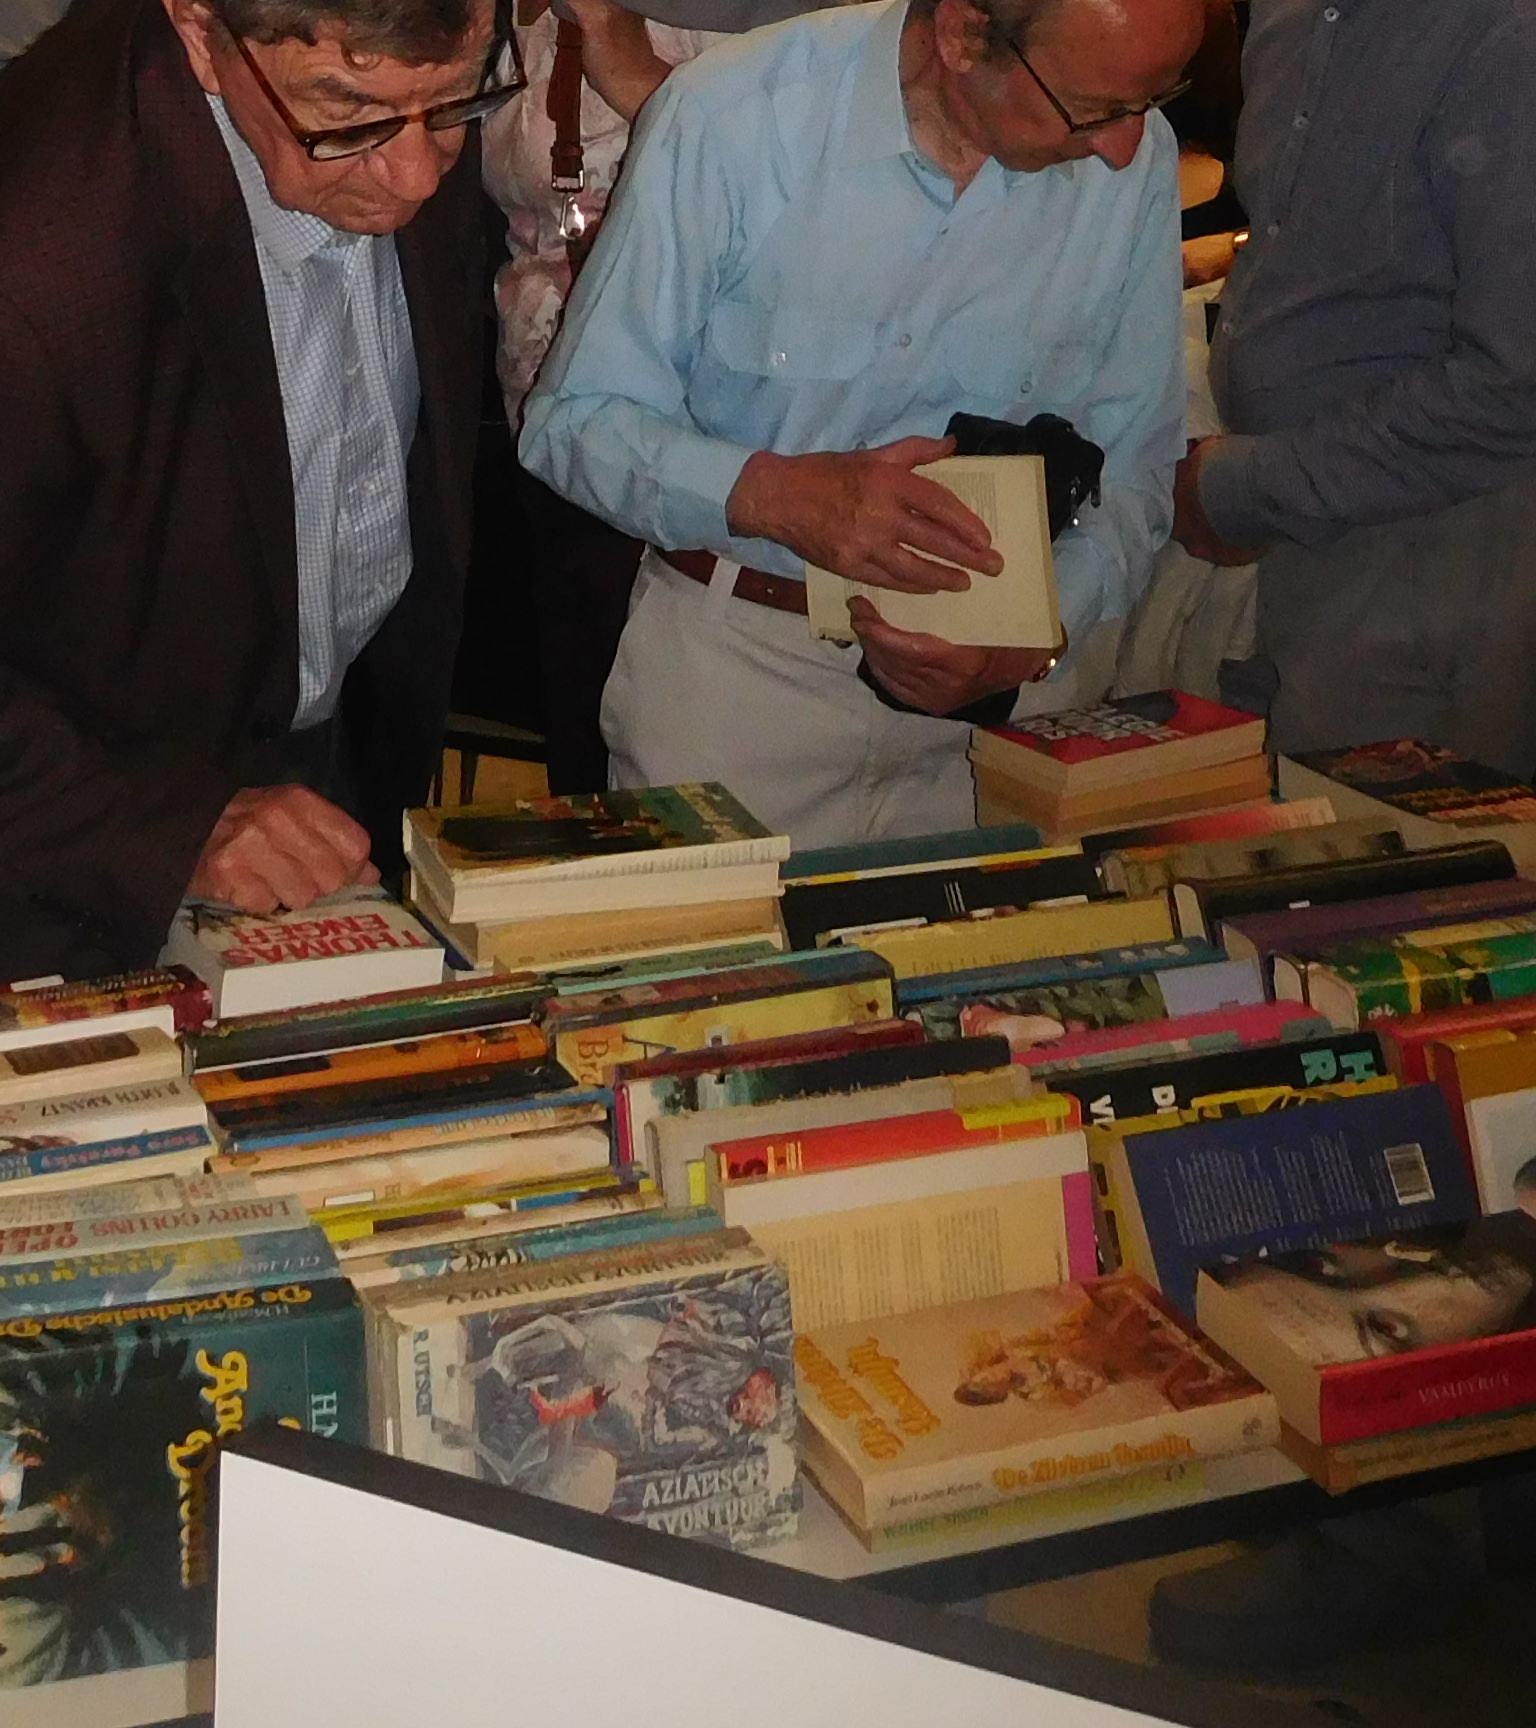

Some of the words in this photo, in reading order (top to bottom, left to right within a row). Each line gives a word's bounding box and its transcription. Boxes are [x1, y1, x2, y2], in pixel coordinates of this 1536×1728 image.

[221, 927, 426, 964] THOMAS
[230, 912, 389, 946] ENGER
[42, 1288, 257, 1335] Andalusische
[259, 1282, 314, 1309] De
[642, 1462, 769, 1508] AZIATISCH
